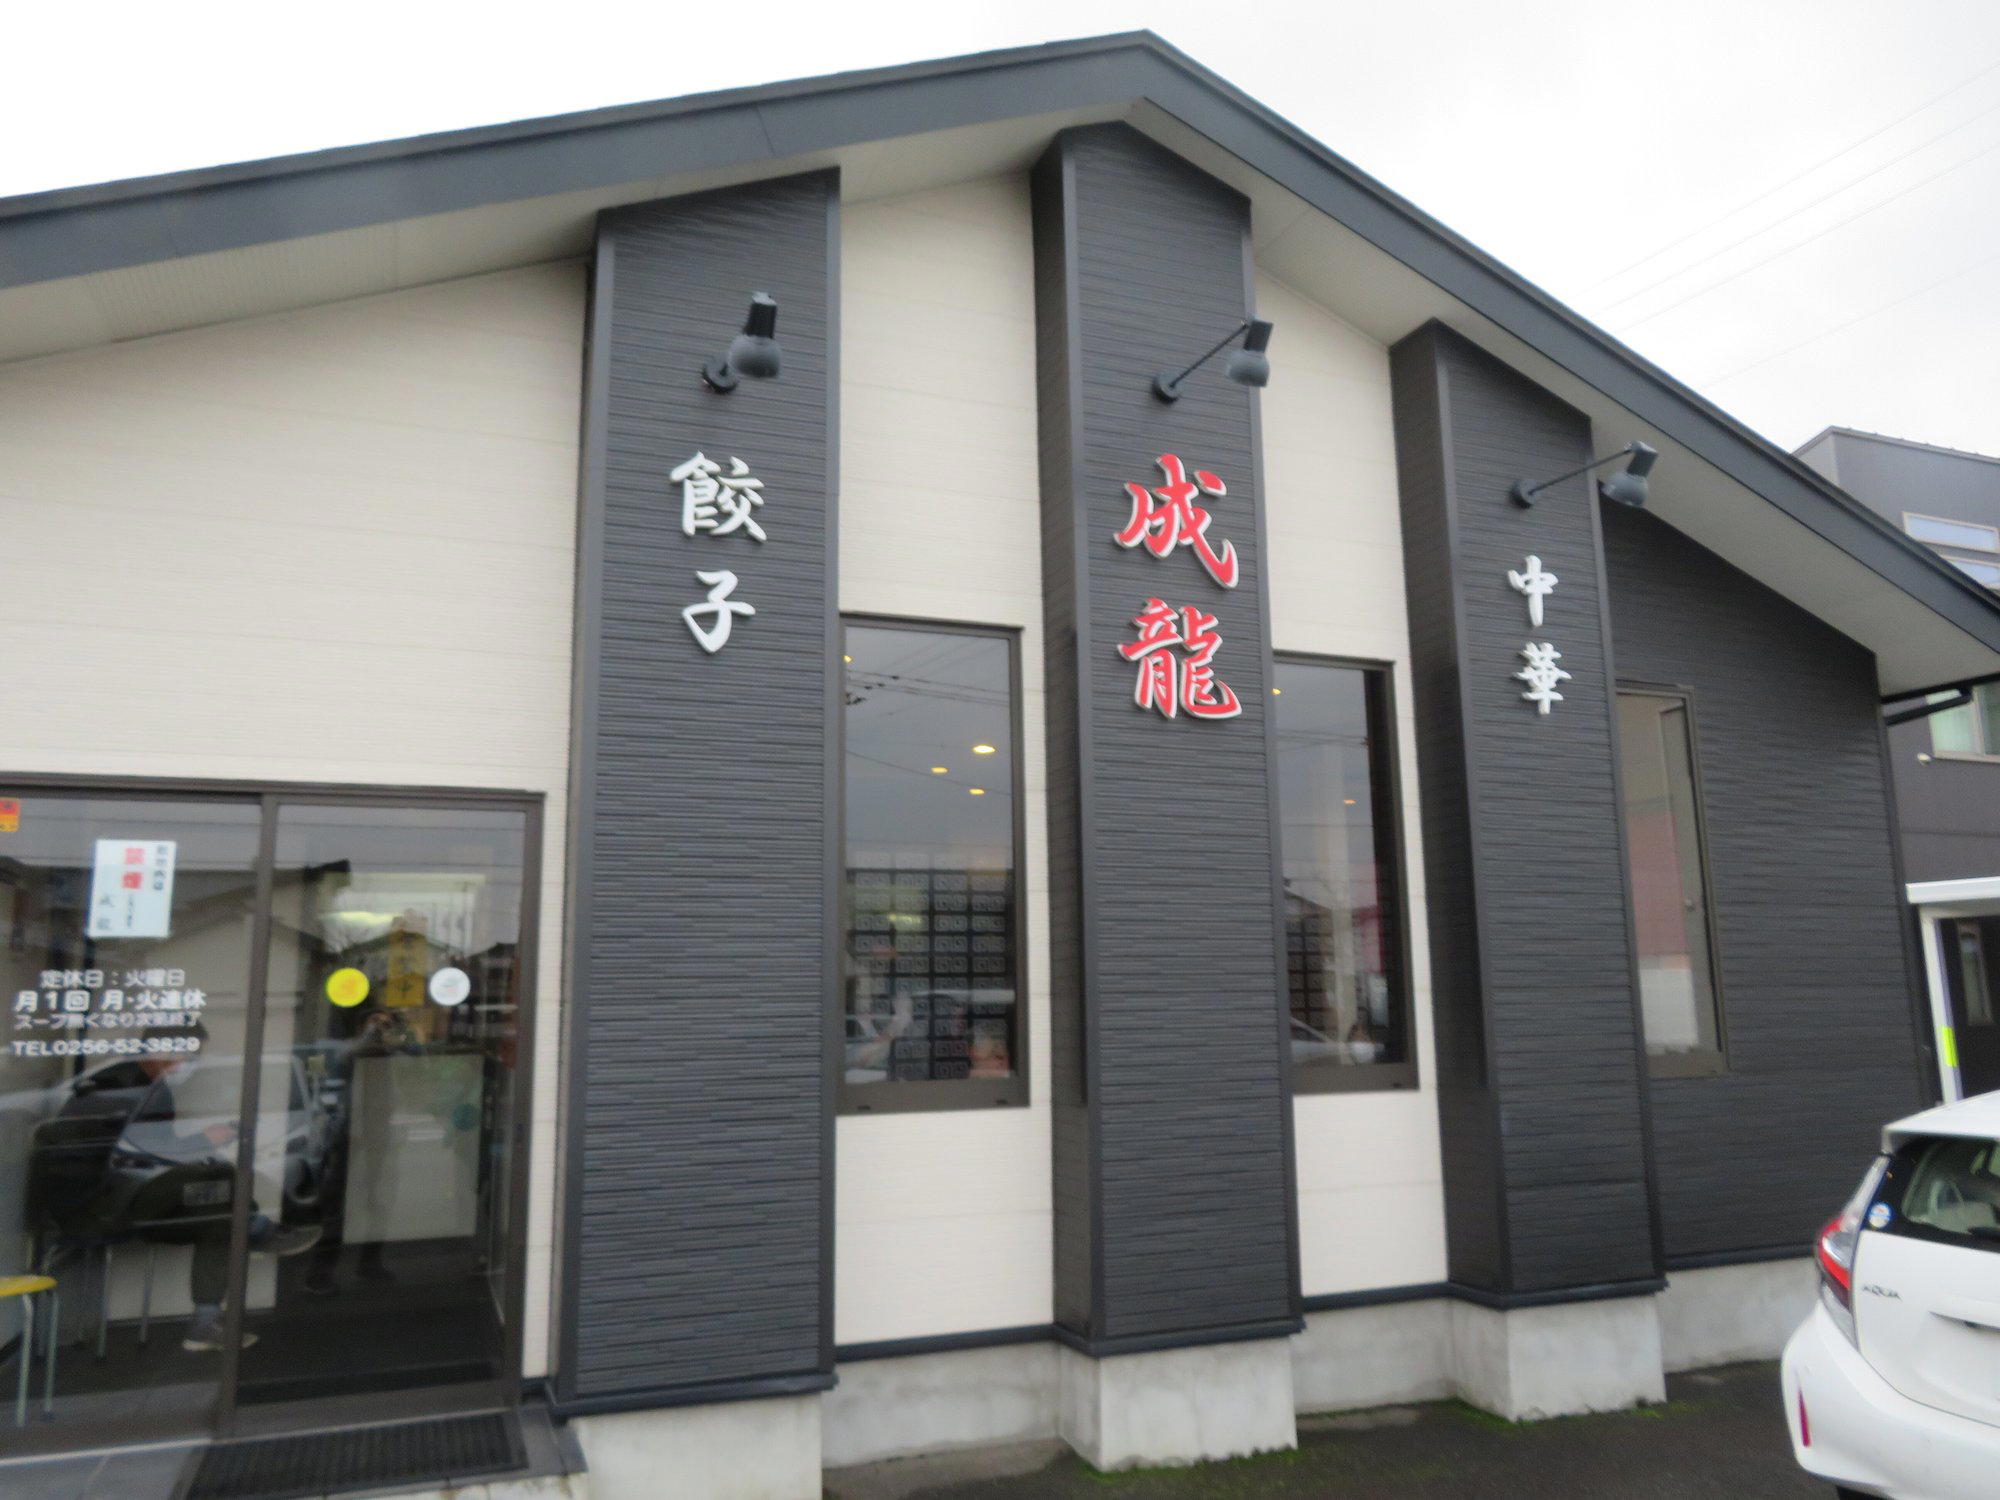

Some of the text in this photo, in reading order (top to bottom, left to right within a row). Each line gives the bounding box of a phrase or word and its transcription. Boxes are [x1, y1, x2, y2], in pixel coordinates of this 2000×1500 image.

[669, 451, 767, 653] 餃子
[1113, 453, 1243, 720] 成龍
[1507, 554, 1573, 715] 中華
